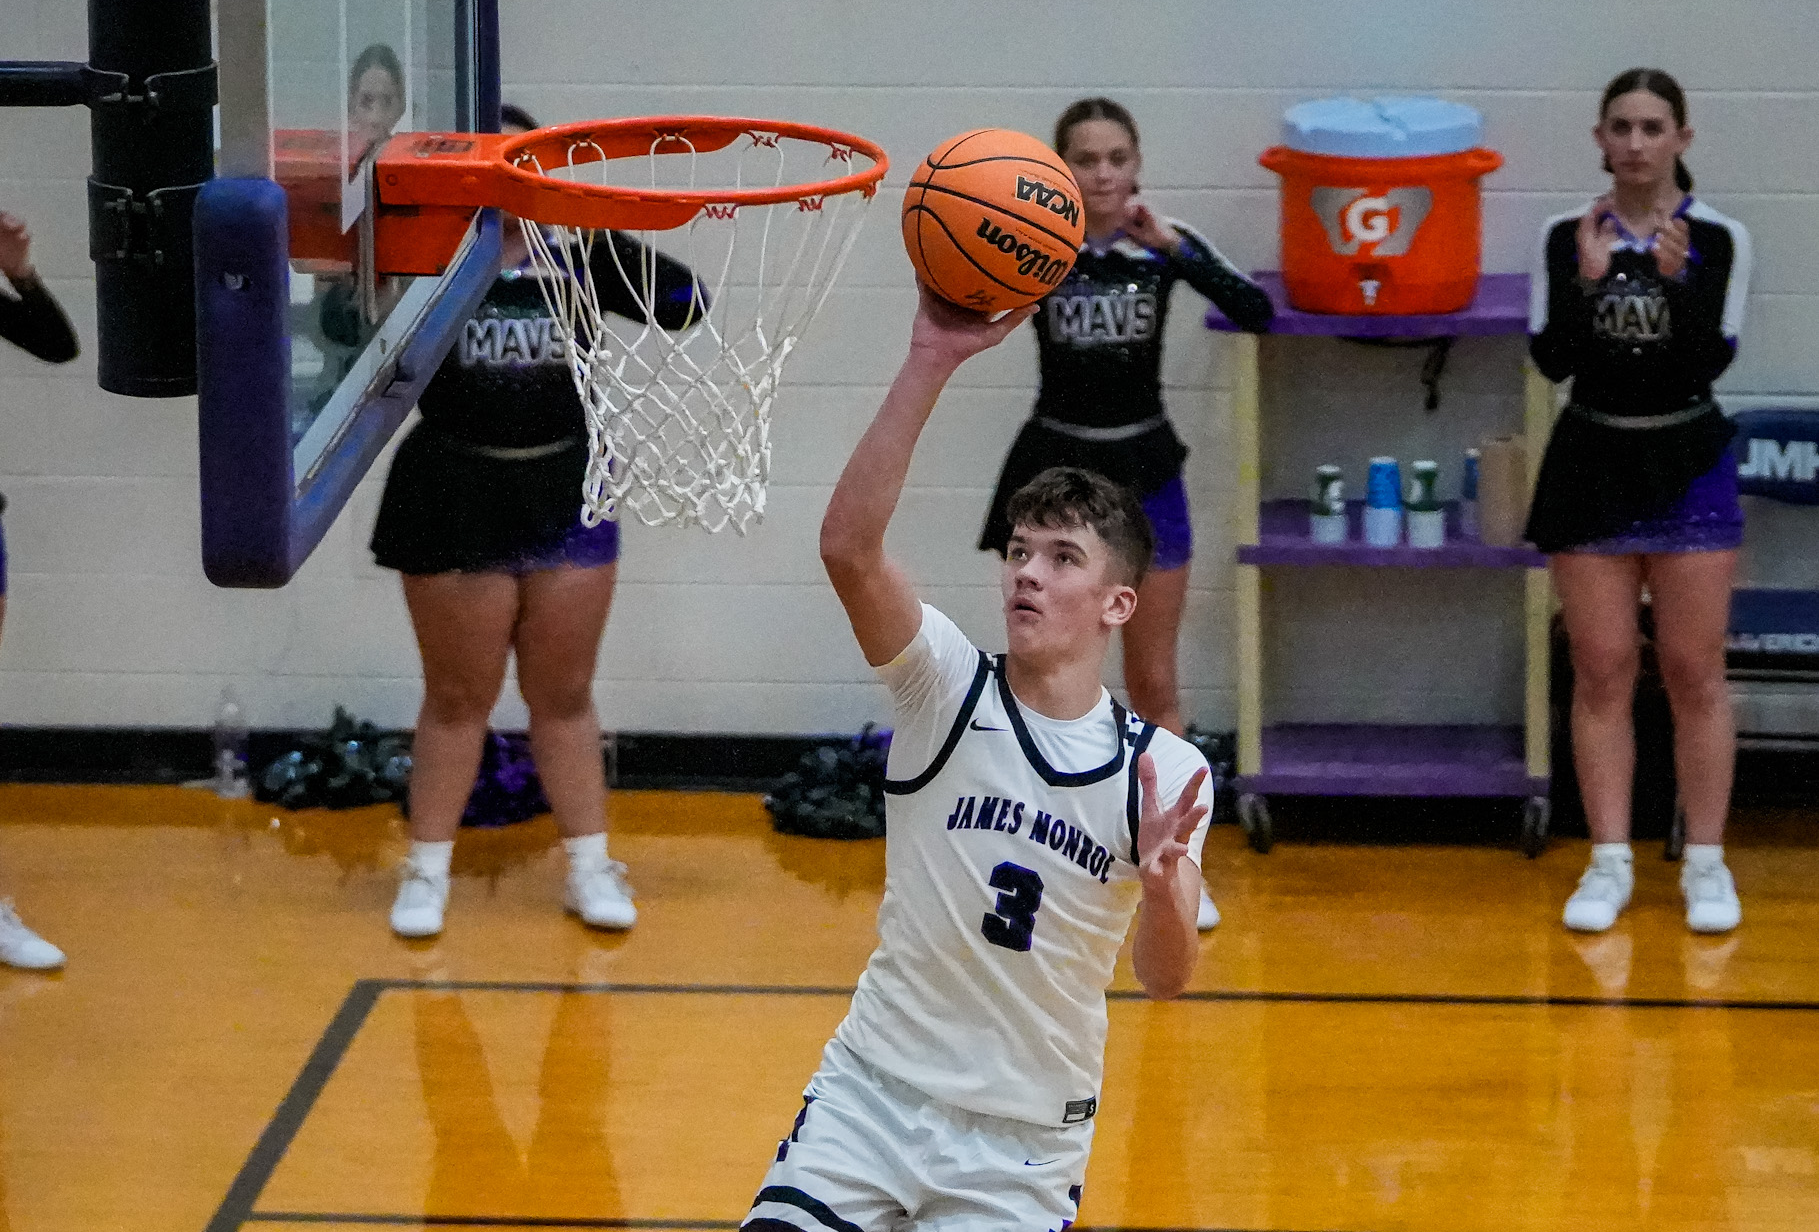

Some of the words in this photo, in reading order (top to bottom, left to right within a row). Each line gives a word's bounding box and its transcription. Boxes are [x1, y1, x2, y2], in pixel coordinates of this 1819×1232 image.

[1015, 175, 1080, 227] NCAA
[976, 217, 1069, 287] Wilson
[1048, 294, 1157, 344] MAVS
[947, 796, 1025, 834] JAMES
[1029, 810, 1116, 884] MONROE
[981, 861, 1044, 952] 3
